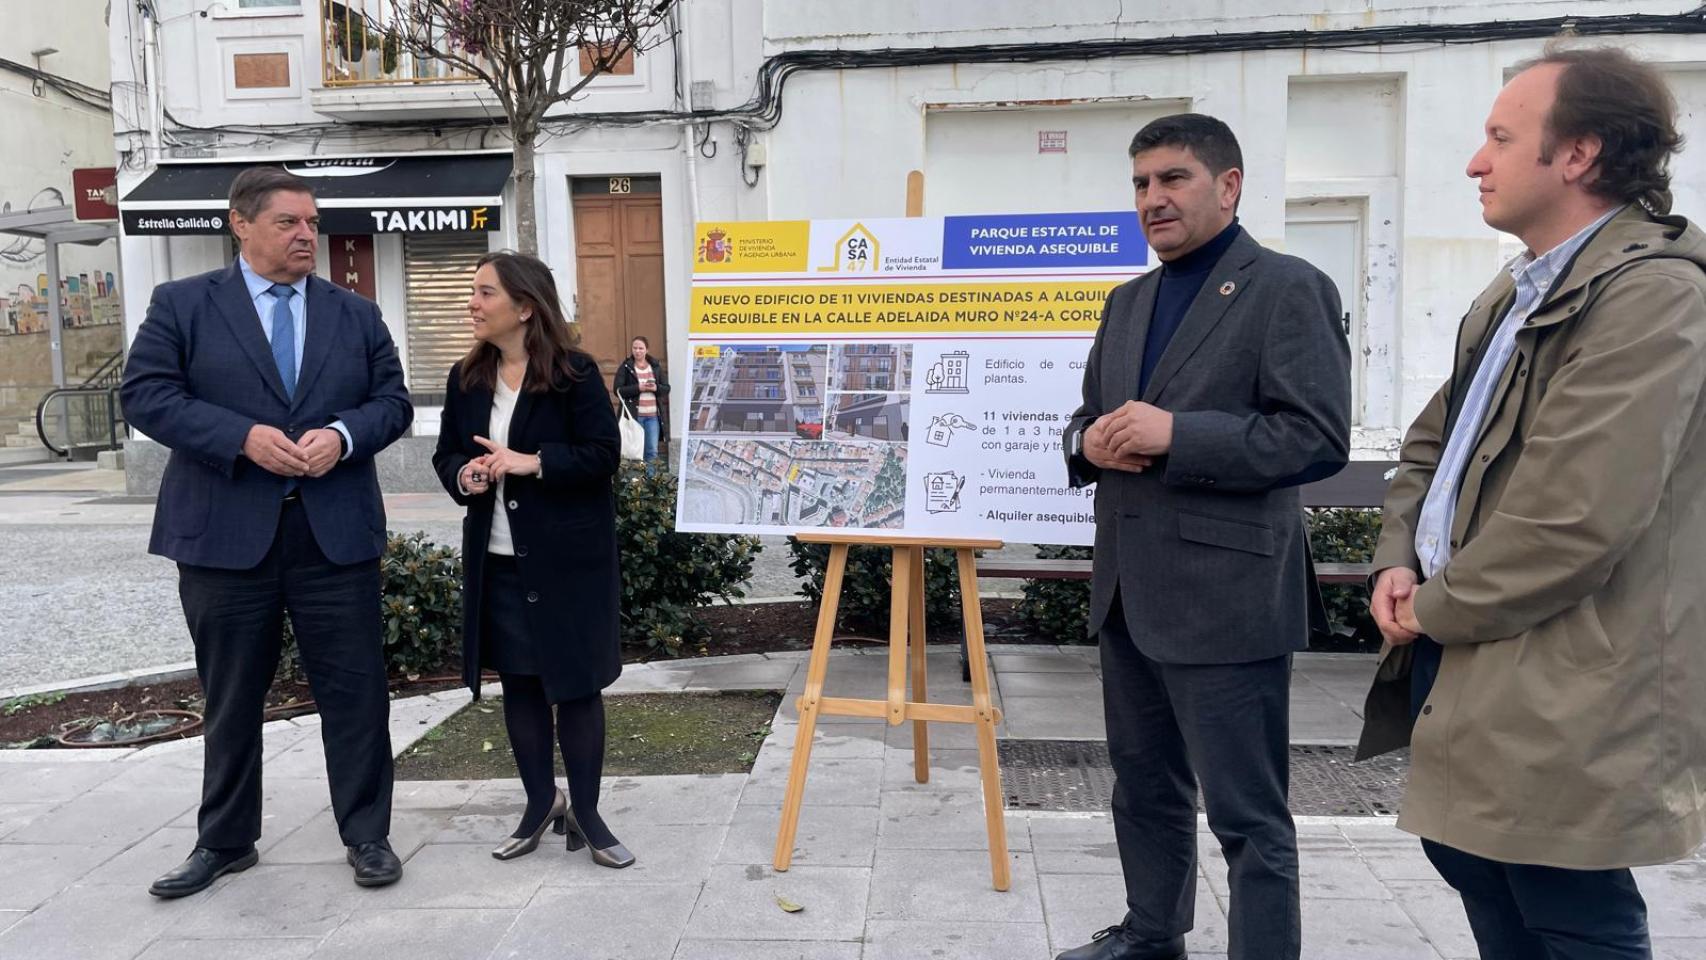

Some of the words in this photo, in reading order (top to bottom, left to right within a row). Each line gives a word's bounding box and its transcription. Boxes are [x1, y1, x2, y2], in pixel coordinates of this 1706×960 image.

[611, 178, 629, 192] 26
[137, 217, 175, 229] Estrella
[176, 217, 210, 229] Galicia
[370, 209, 467, 232] TAKIMI
[970, 227, 1028, 239] PARQUE
[1032, 226, 1095, 237] ESTATAL
[1099, 225, 1119, 236] DE
[847, 238, 868, 249] CA
[969, 244, 1035, 256] VIVIENDA
[1039, 243, 1119, 256] ASEQUIBLE
[847, 249, 868, 260] SA
[345, 239, 358, 293] KIM
[847, 261, 866, 272] 47
[703, 294, 750, 305] NUEVO
[754, 294, 815, 305] EDIFICIO
[819, 293, 838, 304] DE
[841, 293, 852, 304] 11
[857, 292, 934, 304] VIVIENDAS
[939, 291, 1033, 303] DESTINADAS
[1038, 291, 1049, 301] A
[701, 312, 778, 325] ASEQUIBLE
[782, 312, 800, 323] EN
[804, 312, 822, 323] LA
[826, 312, 871, 323] CALLE
[876, 311, 950, 323] ADELAIDA
[954, 310, 999, 322] MURO
[985, 358, 1025, 369] Edificio
[1040, 359, 1054, 369] de
[984, 373, 1028, 386] plantas.
[983, 411, 995, 421] 11
[1002, 410, 1059, 421] viviendas
[982, 425, 996, 435] de
[1005, 425, 1010, 435] 1
[1033, 426, 1041, 435] 3
[981, 441, 1001, 449] con
[1004, 440, 1039, 452] garaje
[1043, 442, 1050, 451] y
[988, 468, 1036, 480] Vivienda
[980, 484, 1081, 497] permanentemente
[986, 509, 1033, 522] Alquiler
[1036, 511, 1095, 525] asequible
